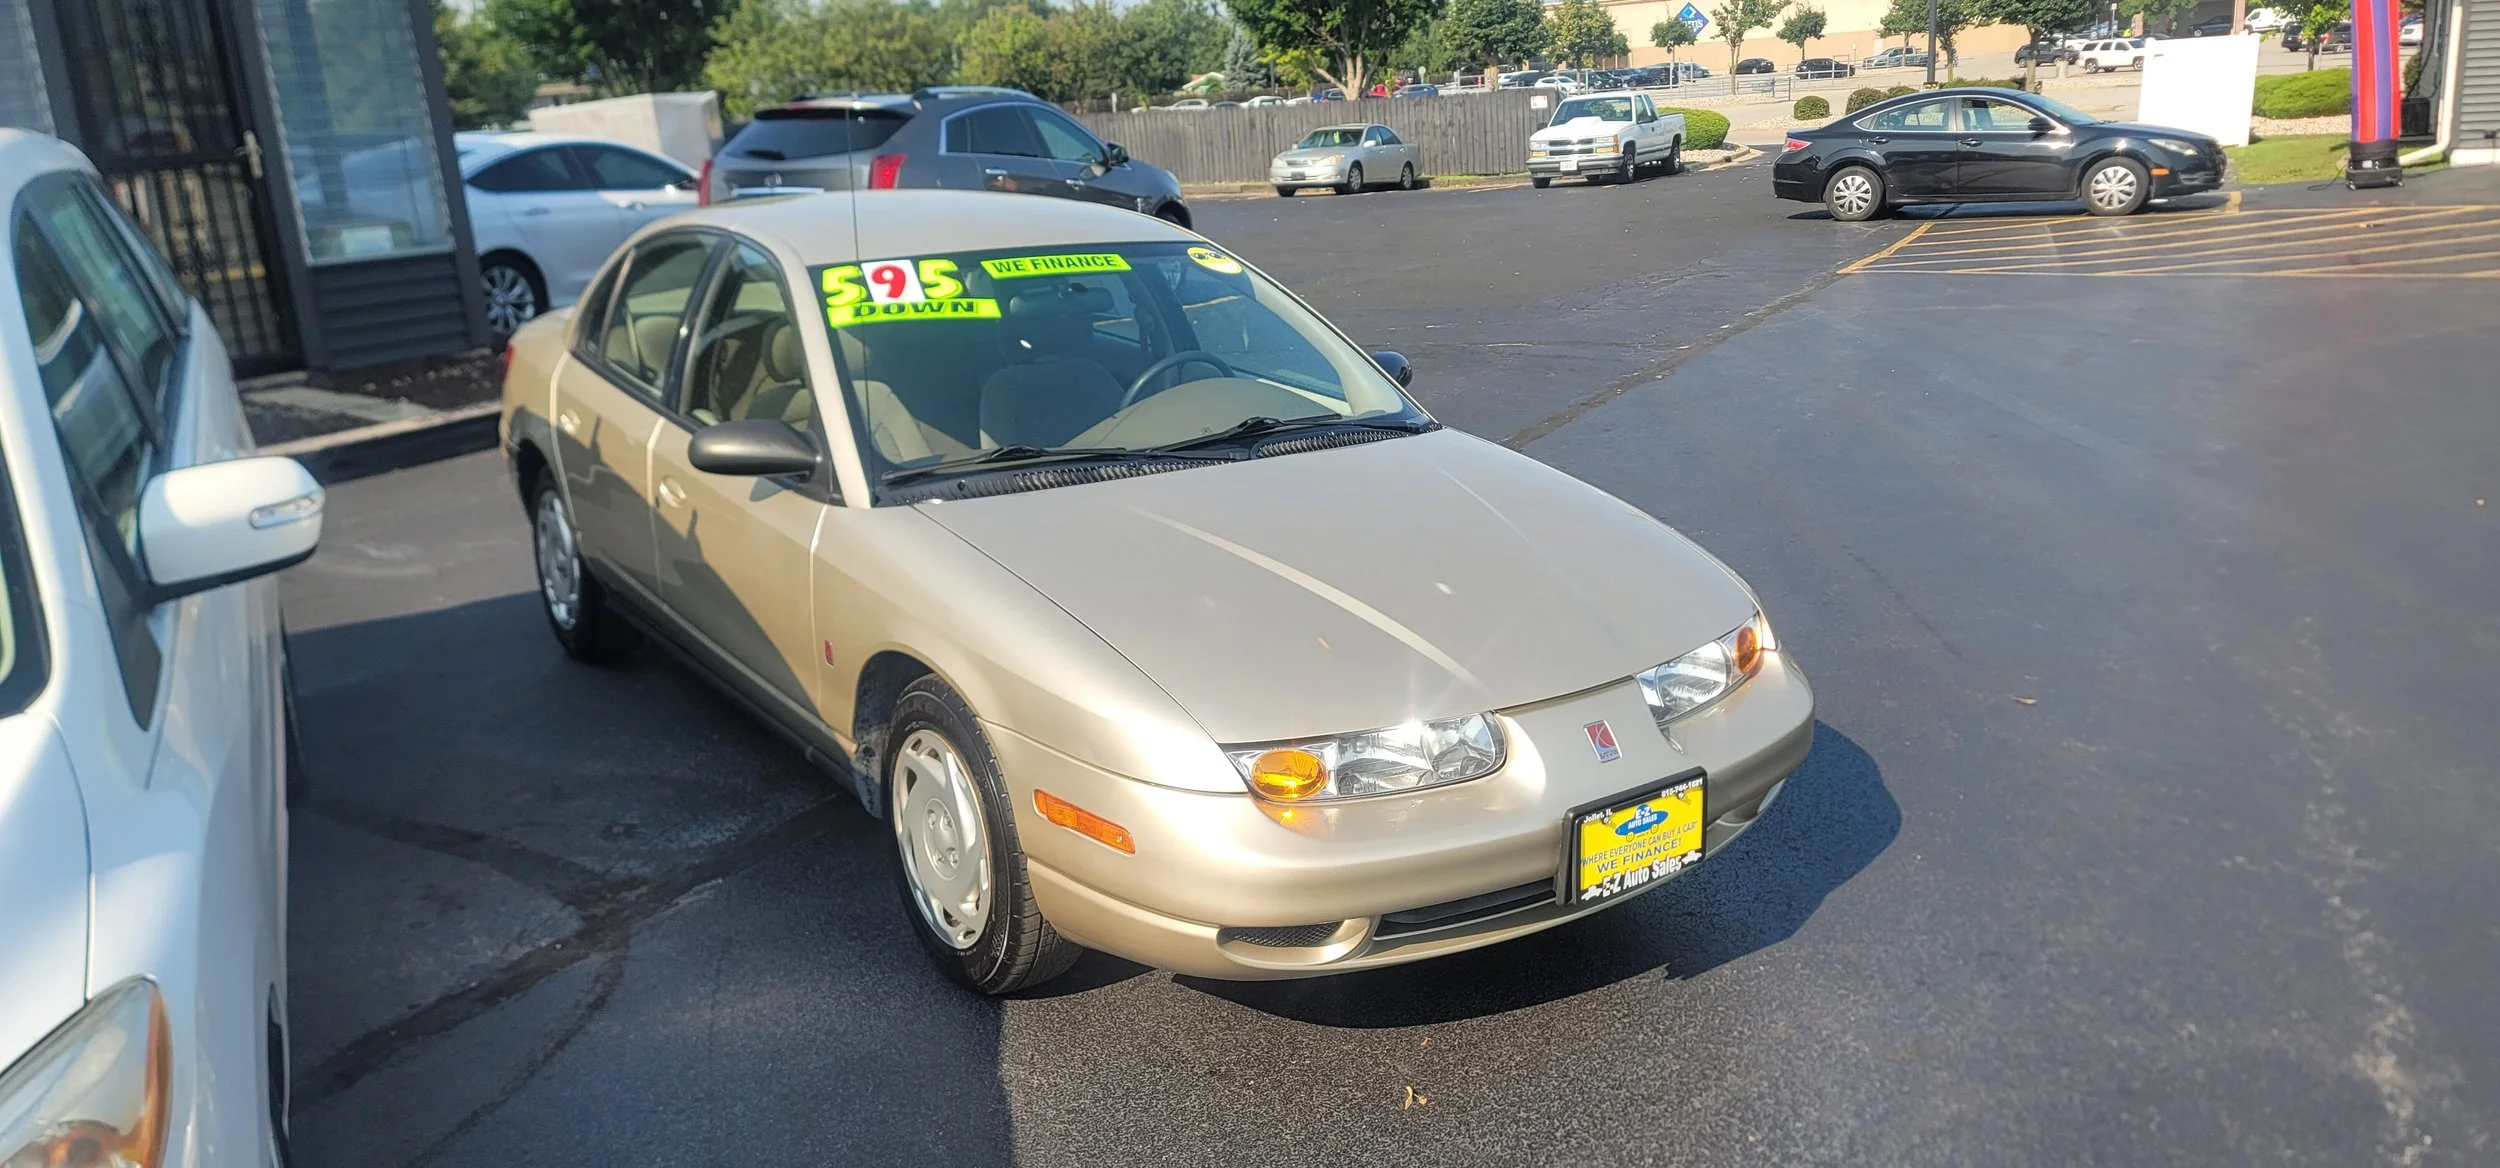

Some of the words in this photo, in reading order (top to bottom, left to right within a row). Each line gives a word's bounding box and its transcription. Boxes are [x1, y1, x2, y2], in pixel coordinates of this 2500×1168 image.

[992, 260, 1025, 274] WE
[1032, 255, 1116, 271] FINANCE
[822, 259, 963, 307] 595
[854, 300, 976, 317] DOWN
[1628, 819, 1642, 830] AUTO
[1642, 813, 1658, 825] SALES
[1635, 806, 1651, 819] E-Z
[1597, 859, 1618, 874] WE
[1623, 837, 1682, 866] FINANCE!
[1610, 839, 1646, 858] EVERYONE
[1648, 835, 1660, 847] CAN
[1662, 829, 1675, 841] BUY
[1602, 871, 1622, 898] E-Z
[1623, 866, 1650, 890] Auto
[1652, 855, 1682, 879] Sales
